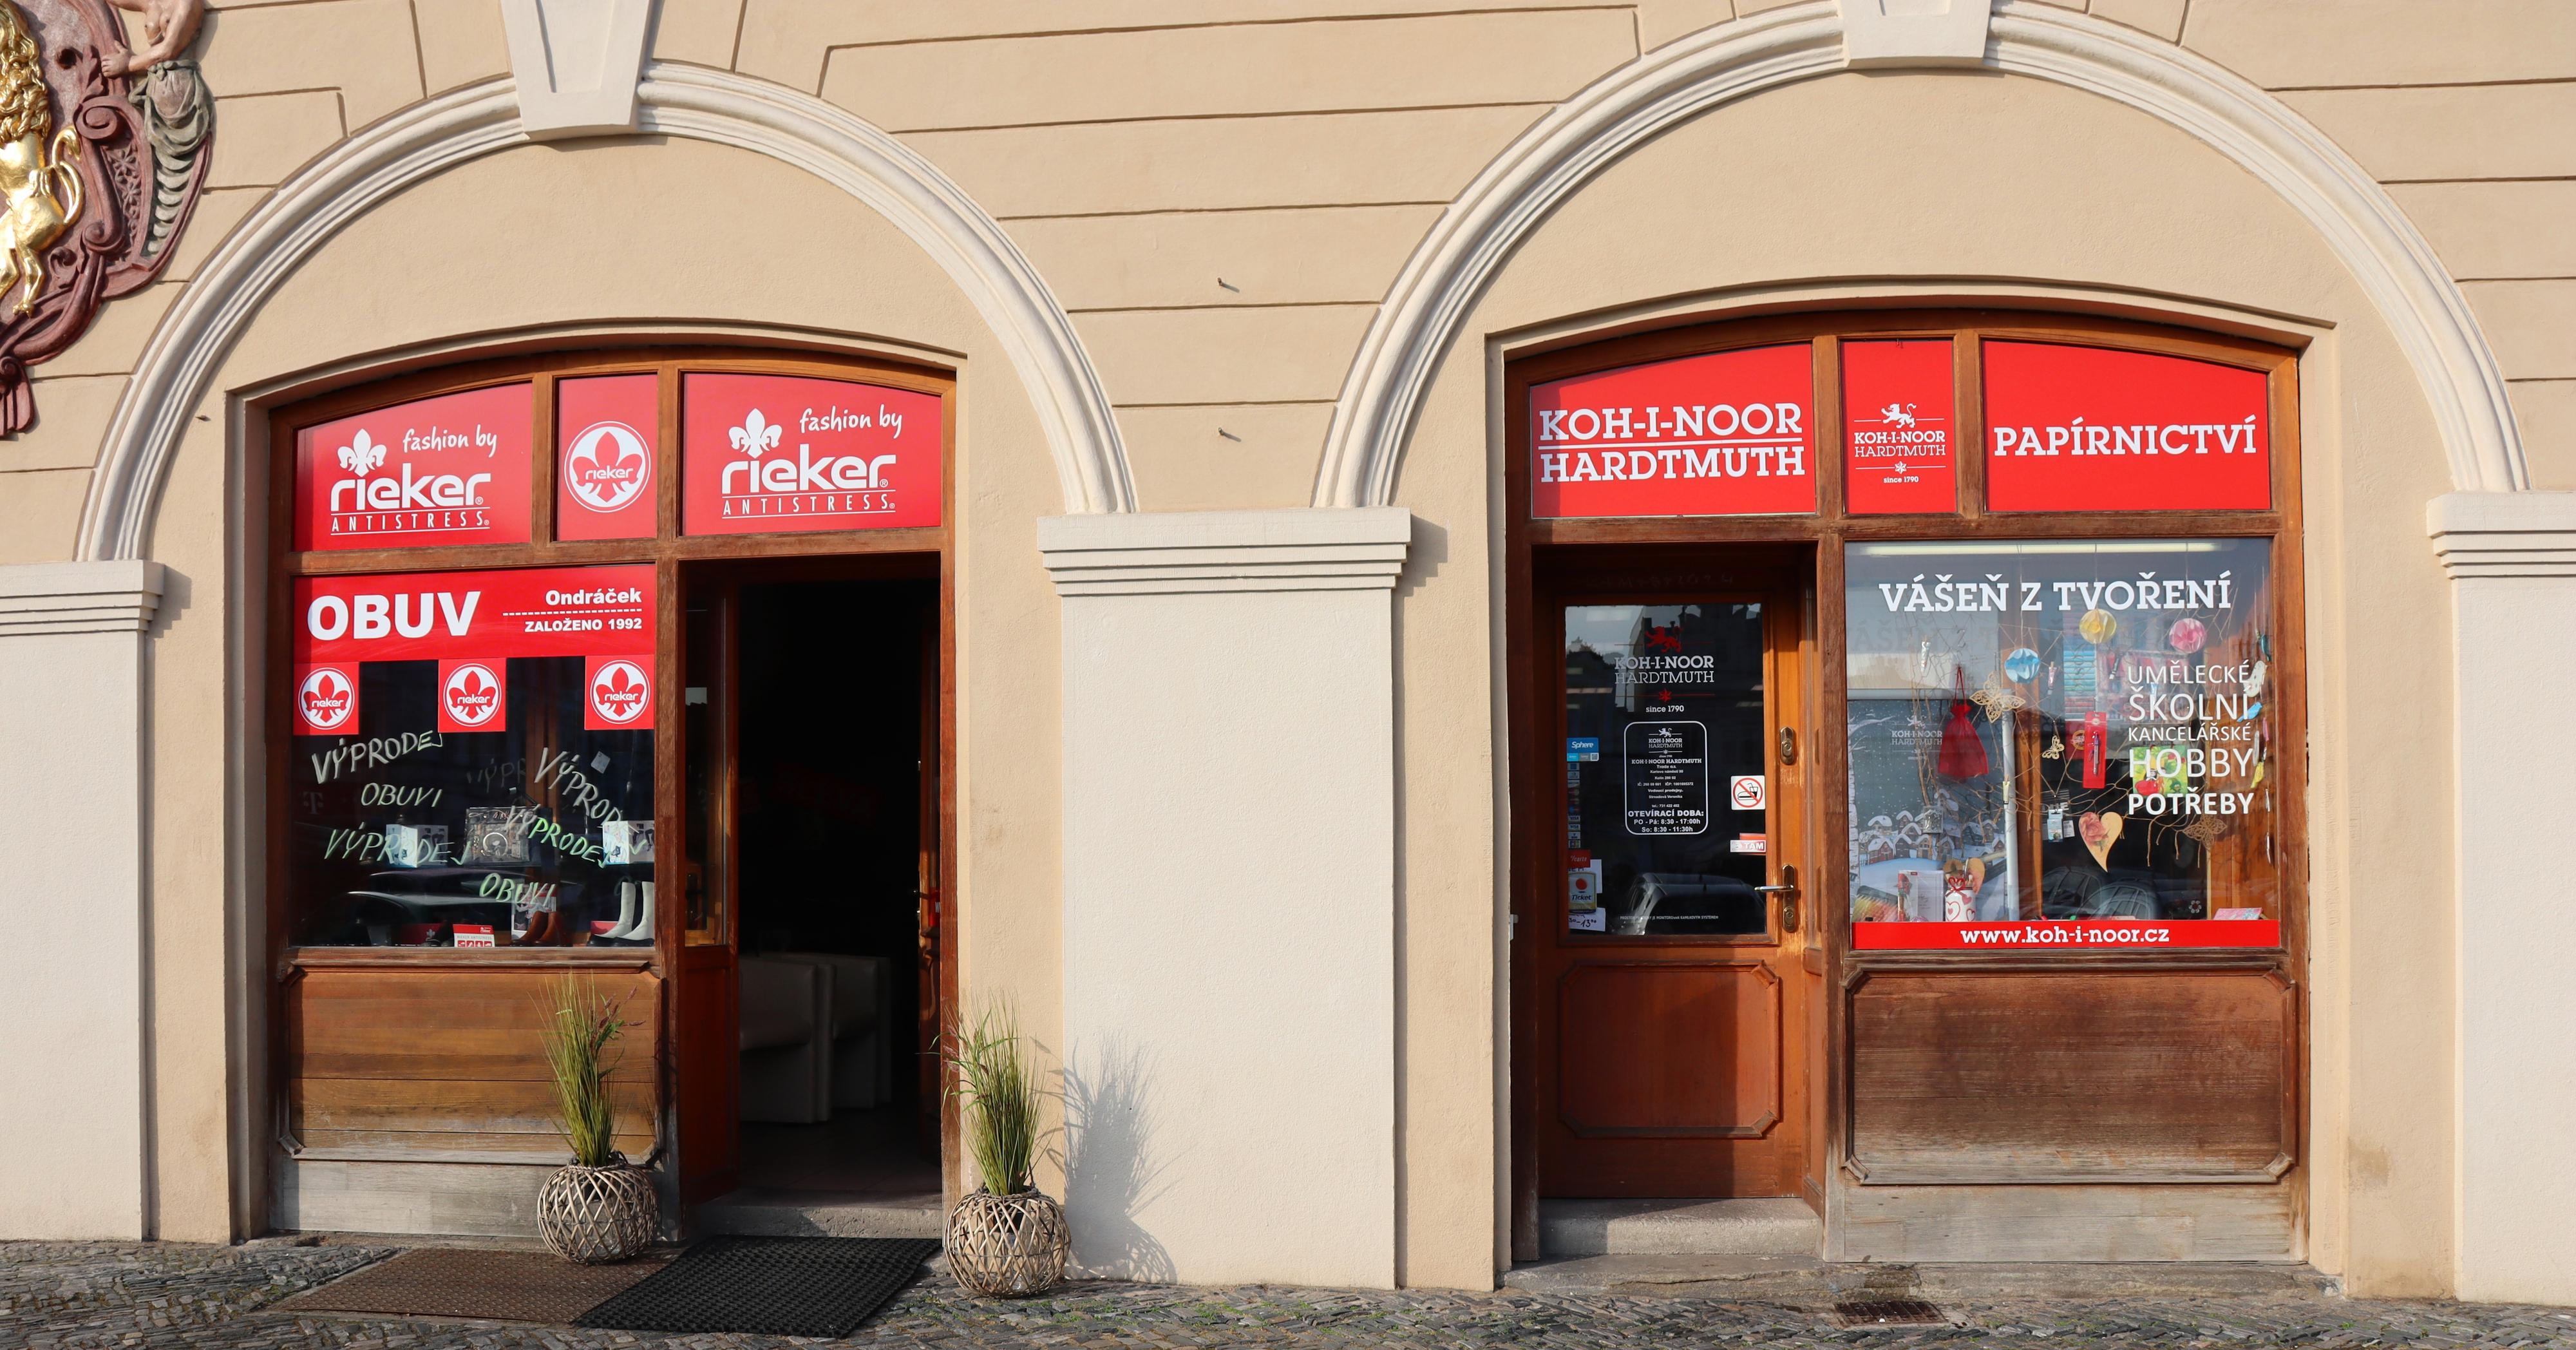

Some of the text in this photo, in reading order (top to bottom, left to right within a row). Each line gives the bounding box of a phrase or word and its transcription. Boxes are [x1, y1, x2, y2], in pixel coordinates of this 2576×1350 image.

[799, 404, 903, 439] fashion by
[1539, 403, 1803, 441] KOH-I-NOOR
[402, 424, 497, 458] fashion by
[1854, 430, 1946, 444] KOH-I-NOOR
[1993, 414, 2257, 456] PAPÍRNICTVÍ
[1854, 444, 1946, 458] HARDTMUTH
[585, 466, 634, 480] rieker
[1539, 446, 1806, 482] HARDTMUTH
[1883, 475, 1919, 484] since 1790
[545, 587, 643, 606] Ondráček
[1879, 570, 2232, 613] VÁŠEŇ Z TVOŘENÍ
[307, 591, 482, 641] OBUV
[524, 617, 643, 633] ZALOŽENO 1992
[1614, 655, 1714, 670] KOH-I-NOOR
[2127, 660, 2250, 684] UMĚLECKÉ
[1615, 670, 1714, 684] HARDTMUTH
[311, 698, 345, 708] rieker
[457, 695, 491, 704] rieker
[604, 692, 638, 701] rieker
[2128, 685, 2252, 721] ŠKOLNÍ
[2128, 722, 2251, 741] KANCELÁŘSKÉ
[1571, 741, 1594, 749] Sphere
[312, 730, 443, 784] VÝPRODEJ
[2129, 748, 2253, 778] HOBBY
[361, 783, 443, 807] OBUVI
[2128, 786, 2255, 815] POTŘEBY
[1628, 808, 1674, 817] OTEVÍRACÍ
[1960, 926, 2170, 944] www.koh-i-noor.cz
